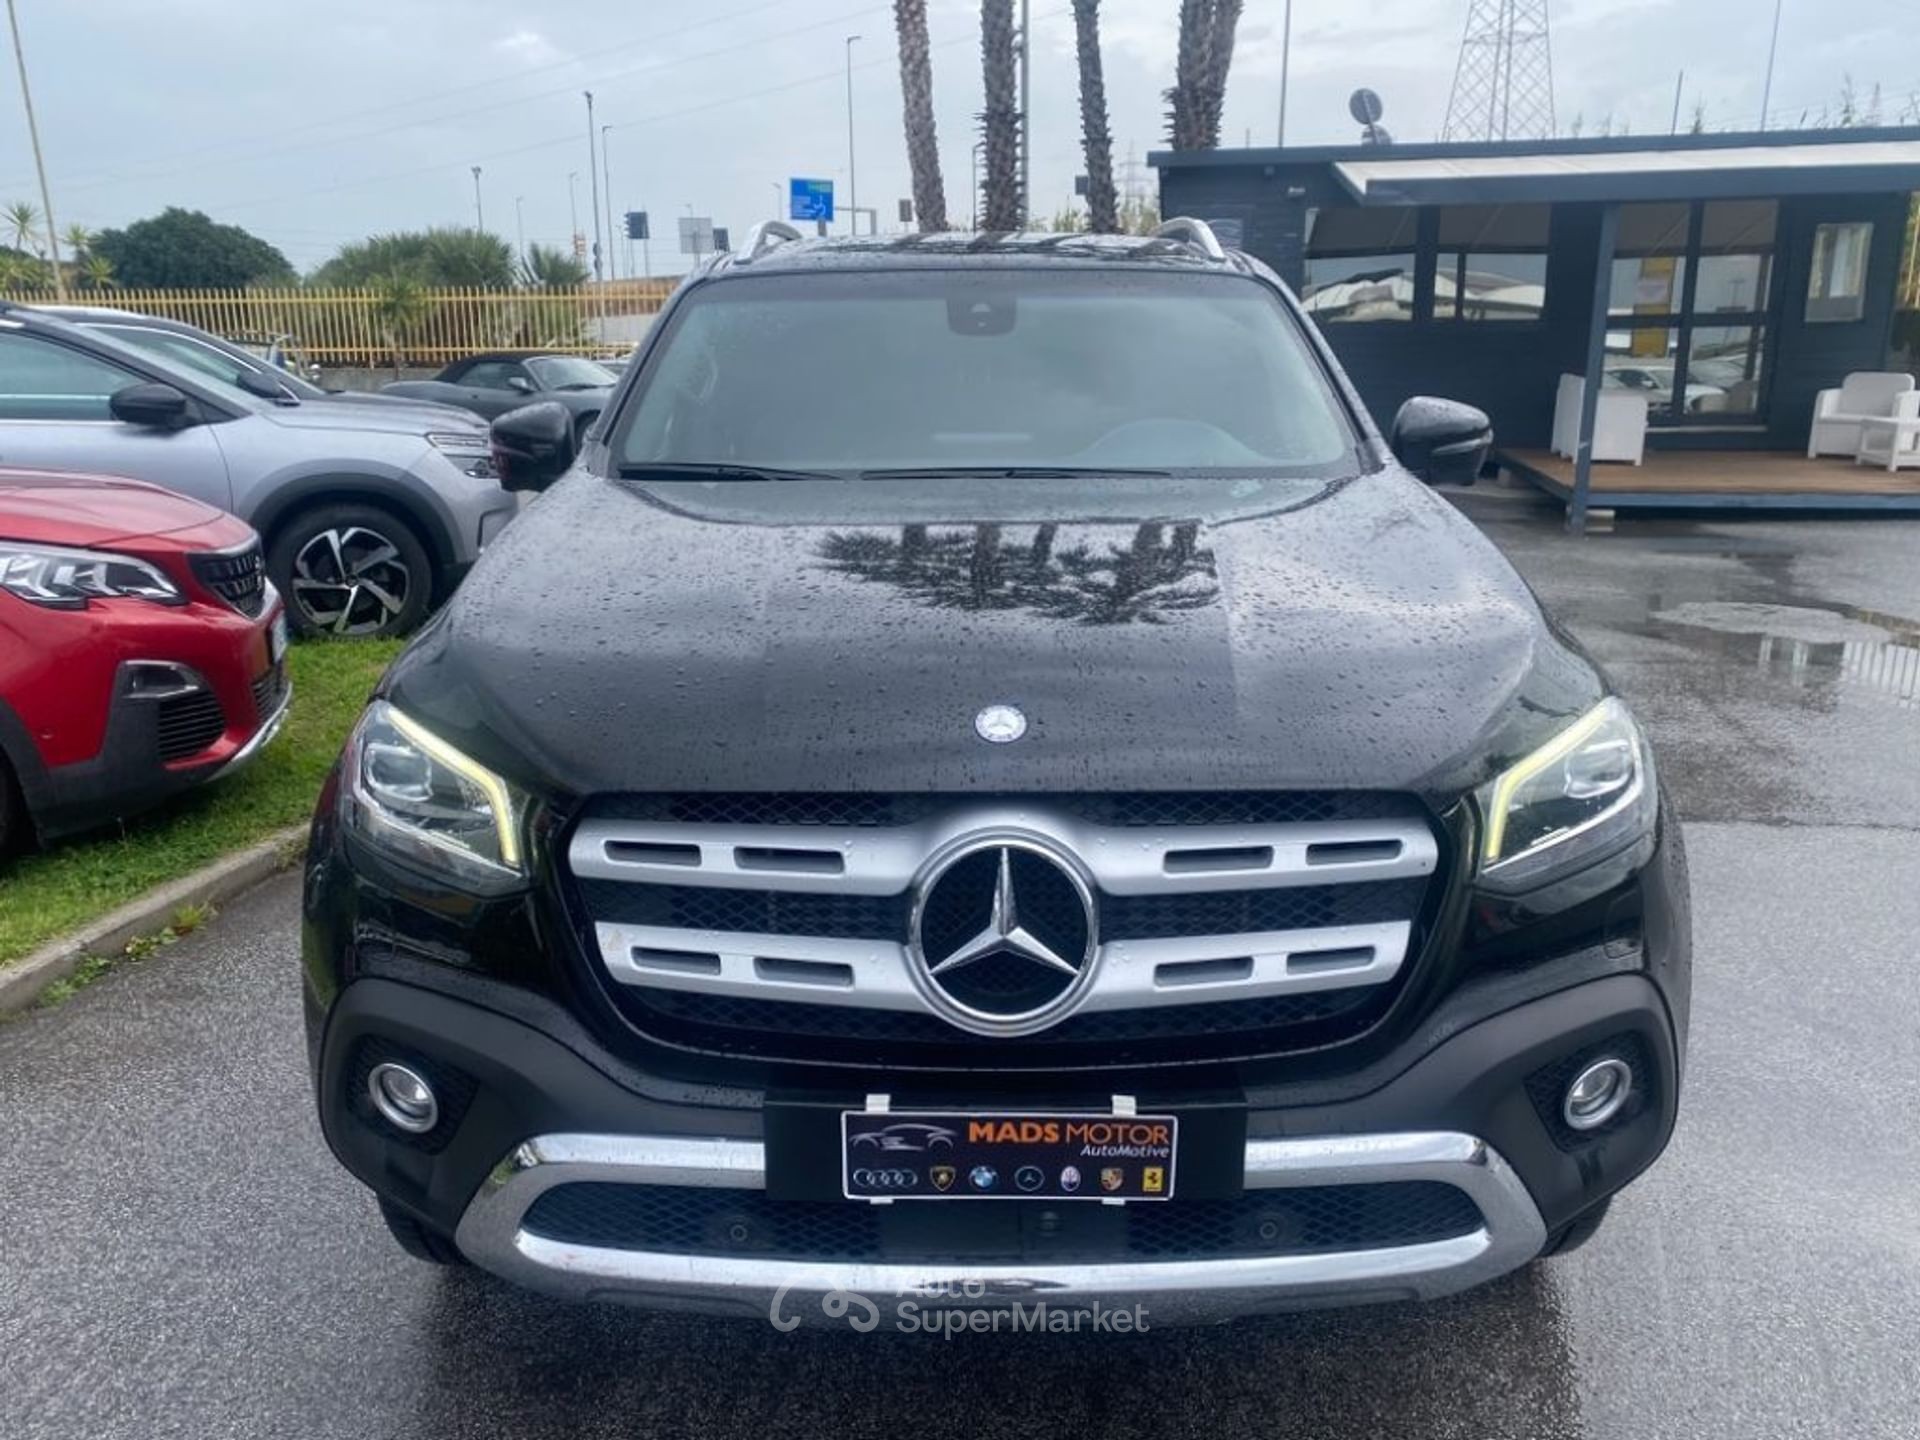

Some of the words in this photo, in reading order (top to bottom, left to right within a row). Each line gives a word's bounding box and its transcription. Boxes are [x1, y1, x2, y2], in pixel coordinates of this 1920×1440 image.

[968, 1121, 1060, 1143] MADS
[1065, 1123, 1169, 1145] MOTOR
[1080, 1143, 1169, 1158] AutoMotive
